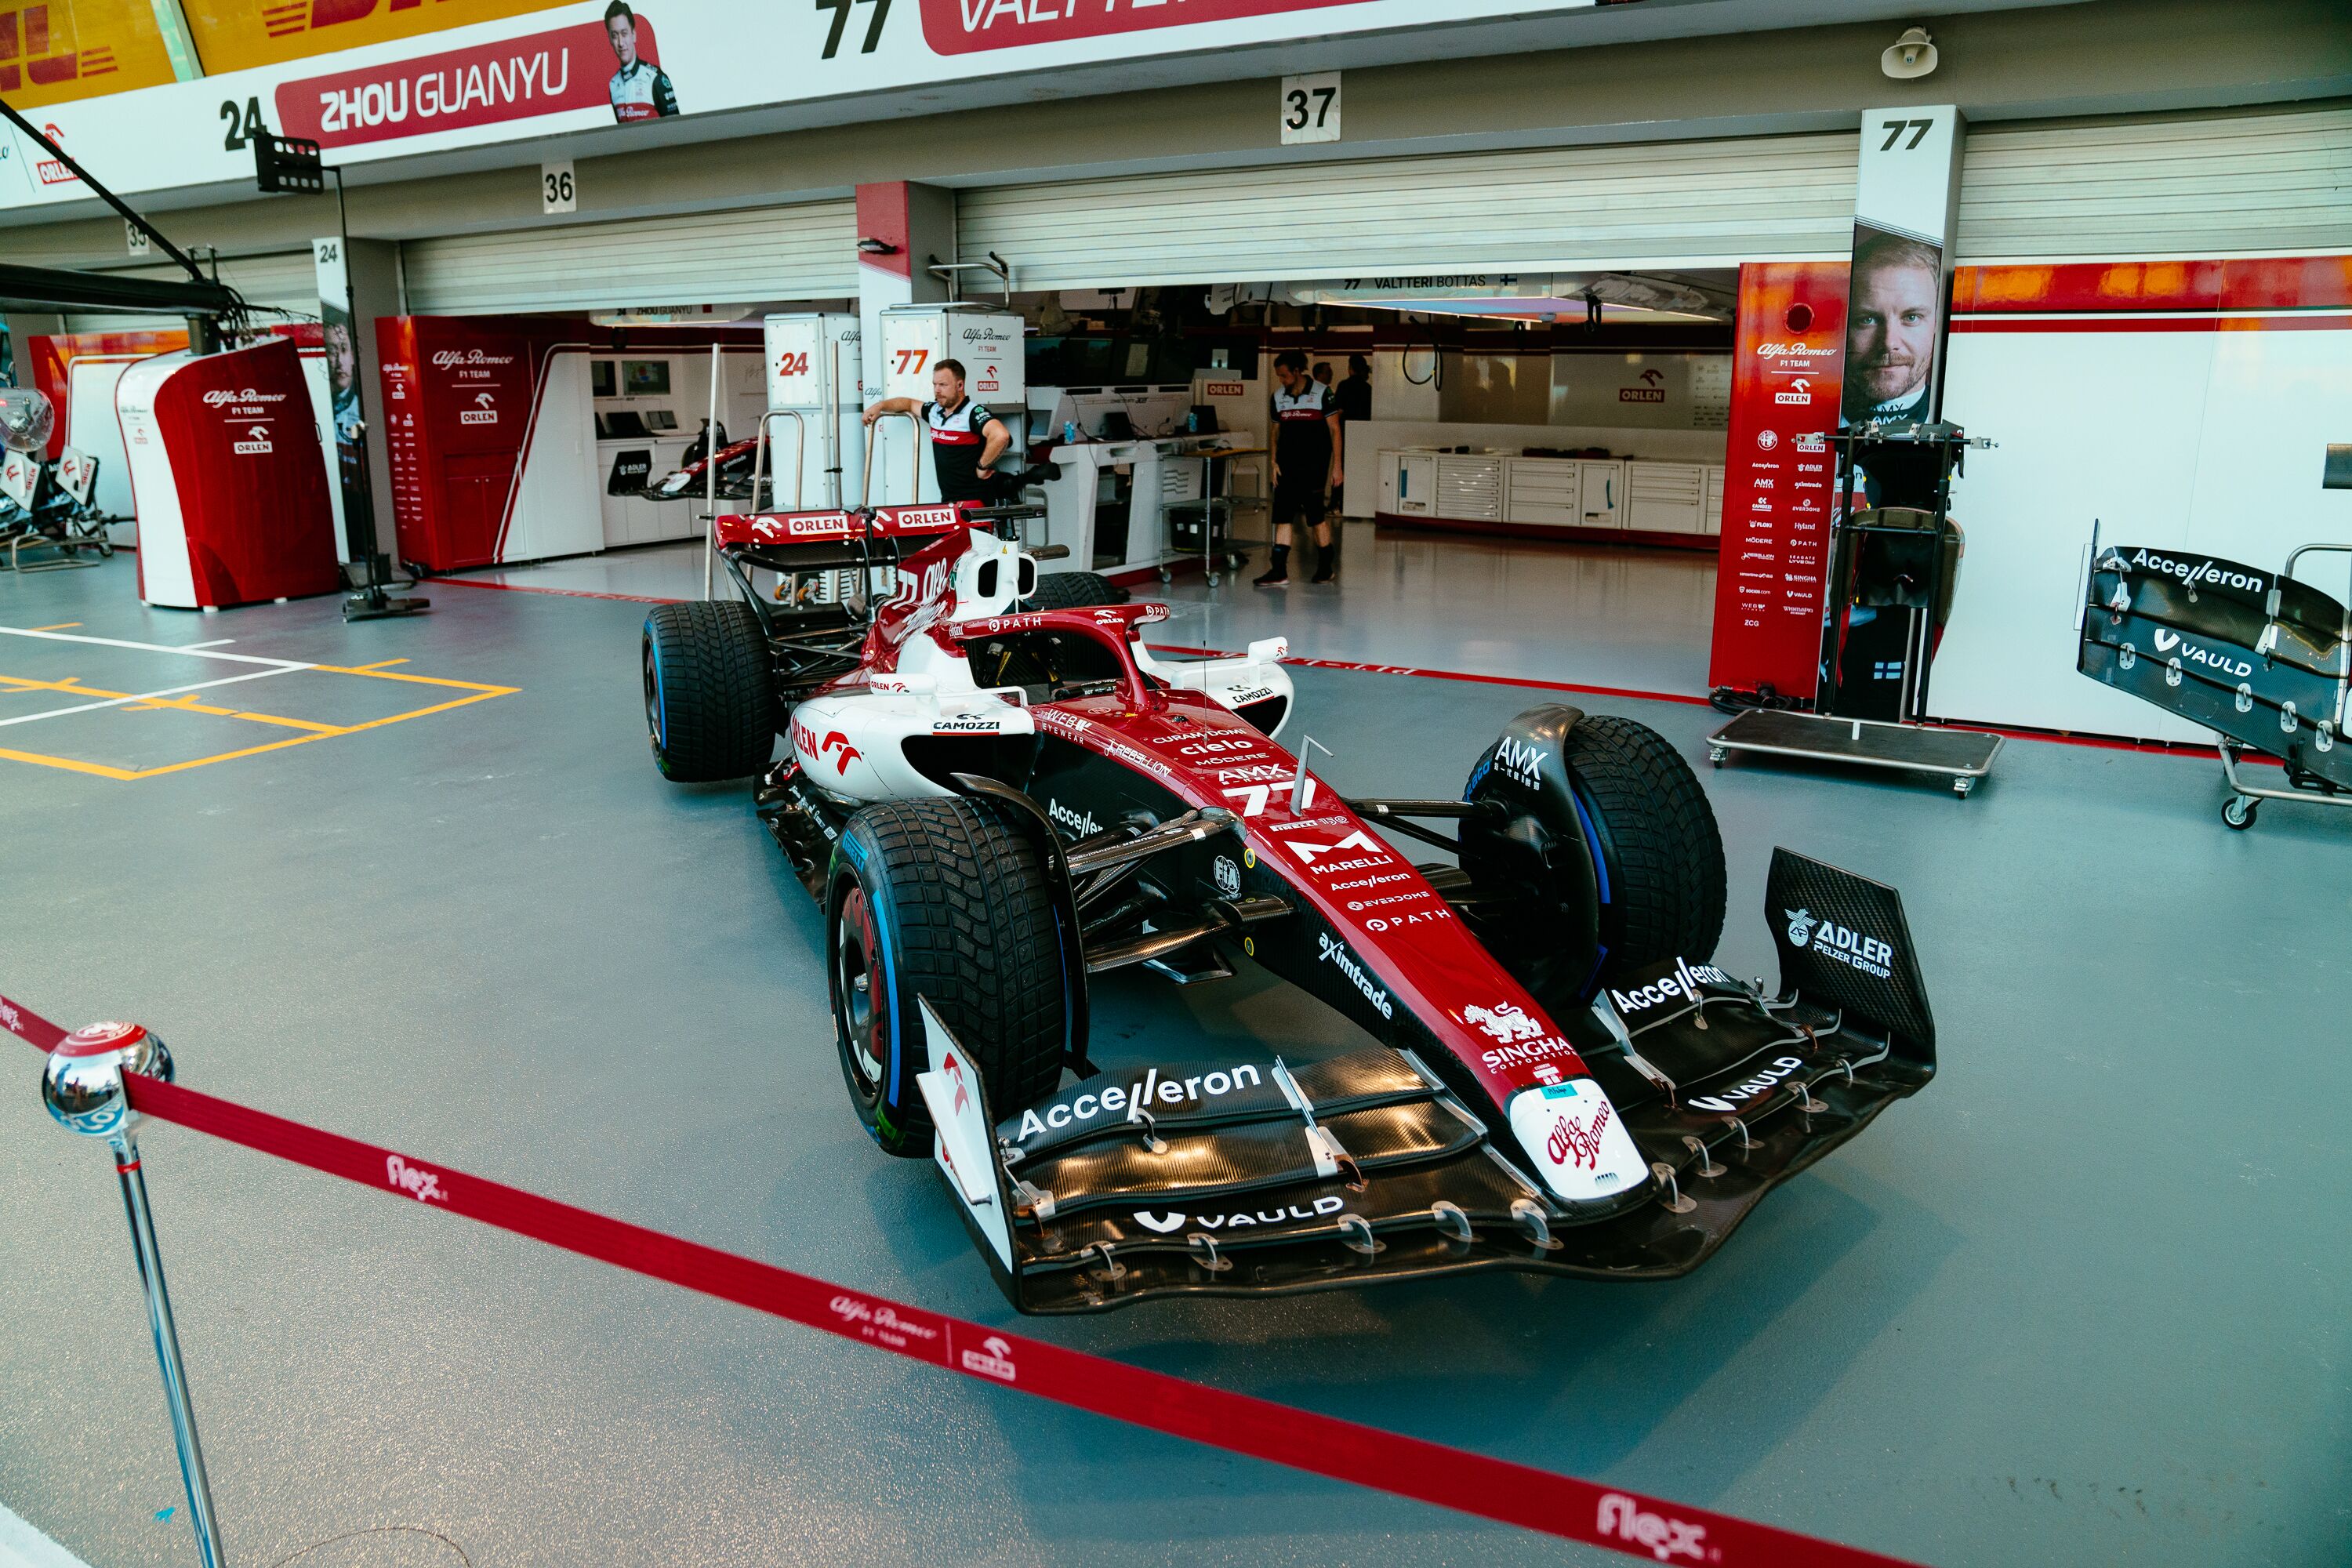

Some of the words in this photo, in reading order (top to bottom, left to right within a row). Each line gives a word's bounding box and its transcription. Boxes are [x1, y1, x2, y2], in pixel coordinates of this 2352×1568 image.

[815, 0, 891, 60] 77
[321, 78, 408, 133] ZHOU
[415, 47, 569, 118] GUANYU
[1286, 87, 1337, 130] 37
[220, 96, 270, 151] 24
[1880, 118, 1934, 151] 77
[39, 163, 78, 184] ORLE
[546, 171, 573, 203] 36
[320, 245, 338, 263] 24
[1344, 278, 1361, 290] 77
[1374, 276, 1432, 289] VALTTERI
[1436, 275, 1486, 287] BOTTAS
[963, 328, 982, 344] Alfa
[983, 328, 1011, 340] Romeo
[432, 350, 467, 370] Alfa
[468, 349, 514, 365] Romeo
[1756, 343, 1789, 360] Alfa
[1789, 342, 1837, 356] Romeo
[780, 352, 809, 376] 24
[896, 350, 928, 375] 77
[978, 382, 998, 390] ORLEN
[1209, 385, 1241, 394] ORLEN
[1622, 390, 1662, 401] ORLEN
[463, 412, 495, 422] ORLEN
[238, 443, 270, 452] ORLEN
[1754, 477, 1773, 486] AMX
[793, 518, 844, 532] ORLEN
[902, 511, 951, 524] ORLEN
[1794, 522, 1816, 531] Hyland
[2131, 548, 2263, 593] Accelleron
[1003, 616, 1041, 630] PATH
[1744, 619, 1759, 627] ZCG
[2180, 641, 2252, 677] VAULD
[871, 681, 890, 691] ORLEN
[1232, 687, 1274, 703] CAMOZZI
[933, 721, 1000, 730] CAMOZZI
[1047, 708, 1077, 728] WEB
[1042, 723, 1084, 745] EYEWEAR
[1152, 731, 1206, 744] CURAM
[1180, 740, 1253, 755] cielo
[1494, 735, 1549, 781] AMX
[1218, 763, 1290, 782] AMX
[1221, 778, 1317, 817] 77
[1310, 855, 1394, 875] MARELLI
[1330, 872, 1411, 891] Accelleron
[1365, 891, 1431, 907] EVERDOME
[1391, 909, 1451, 927] PATH
[1814, 919, 1893, 967] ADLER
[1813, 939, 1850, 964] PELZER
[1852, 953, 1891, 980] GROUP
[1318, 931, 1392, 1020] aximtrade
[1611, 956, 1730, 1014] Accelleron
[1482, 1036, 1573, 1069] SINGHA
[1730, 1056, 1802, 1105] VAULD
[1017, 1062, 1261, 1143] Accelleron
[1547, 1115, 1581, 1165] Alfa
[1570, 1100, 1610, 1171] Romeo
[1196, 1195, 1345, 1229] VAULD
